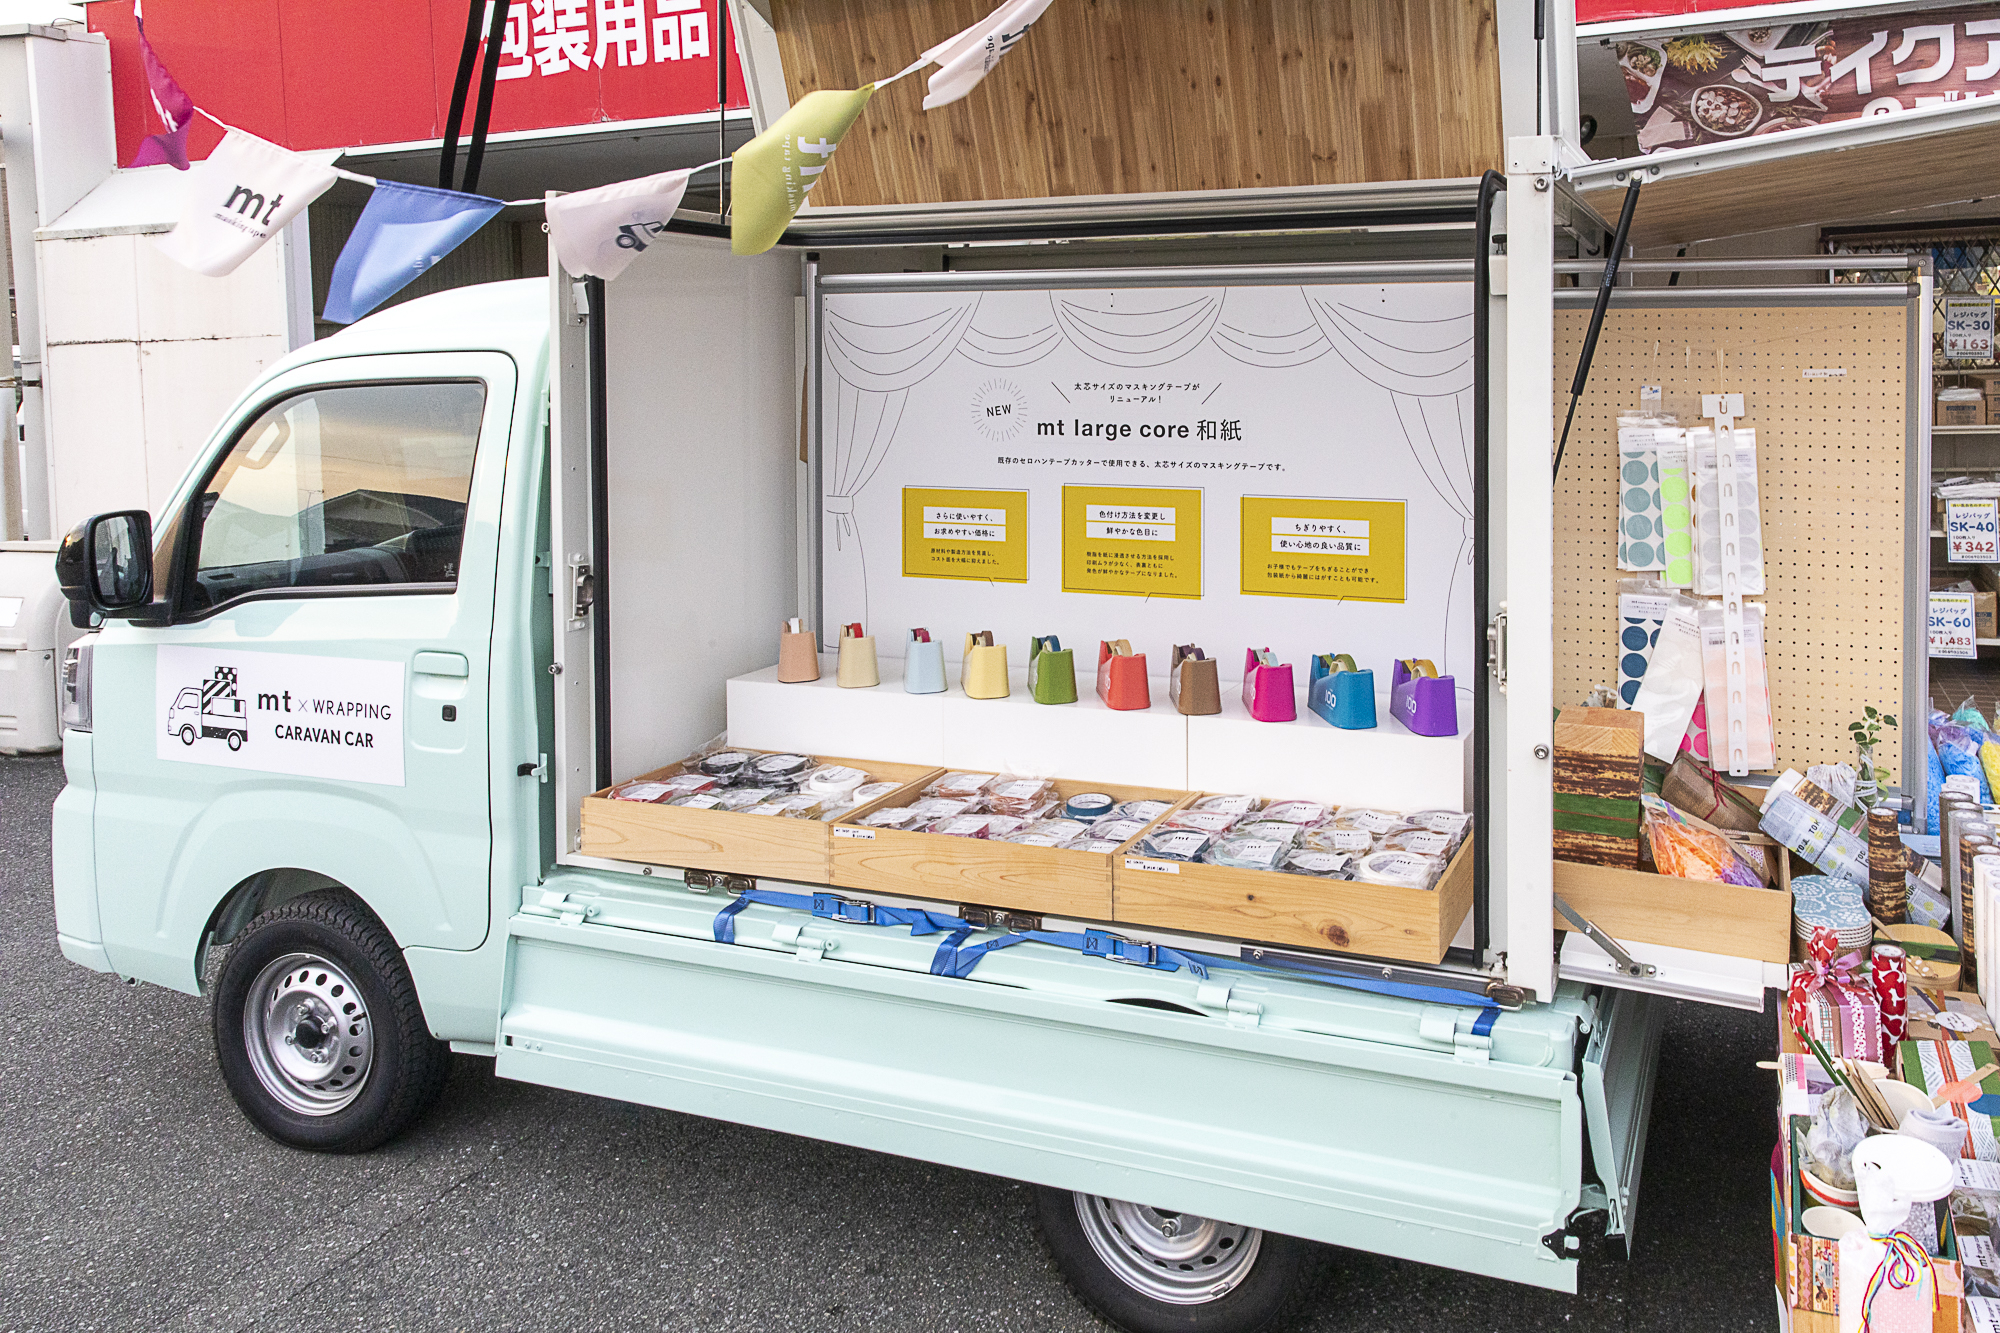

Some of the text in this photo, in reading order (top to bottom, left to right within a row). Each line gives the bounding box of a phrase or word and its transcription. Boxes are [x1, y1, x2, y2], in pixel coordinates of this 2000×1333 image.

[221, 184, 285, 227] mt
[1947, 320, 1991, 331] SK-30
[1074, 382, 1201, 392] 太芯サイズのマスキングテープが
[986, 404, 1012, 418] NEW
[1037, 418, 1242, 442] mt large core 和紙
[997, 456, 1287, 473] 既存のセロハンテープカッターで使用できる、太芯サイズのマスキングテープです。
[936, 512, 993, 522] さらに使いやすく、
[1099, 510, 1166, 521] 色付け方法を変更し
[1106, 526, 1158, 536] 鮮やかな色目に
[1295, 523, 1347, 534] ちぎりやすく、
[1950, 521, 1995, 532] SK-40
[934, 528, 995, 537] お求めやすい価格に
[1279, 539, 1361, 551] 使い心地の良い品質に
[1929, 616, 1971, 628] SK-60
[258, 690, 292, 713] mt
[313, 698, 392, 720] WRAPPING
[274, 724, 374, 748] CARAVAN CAR
